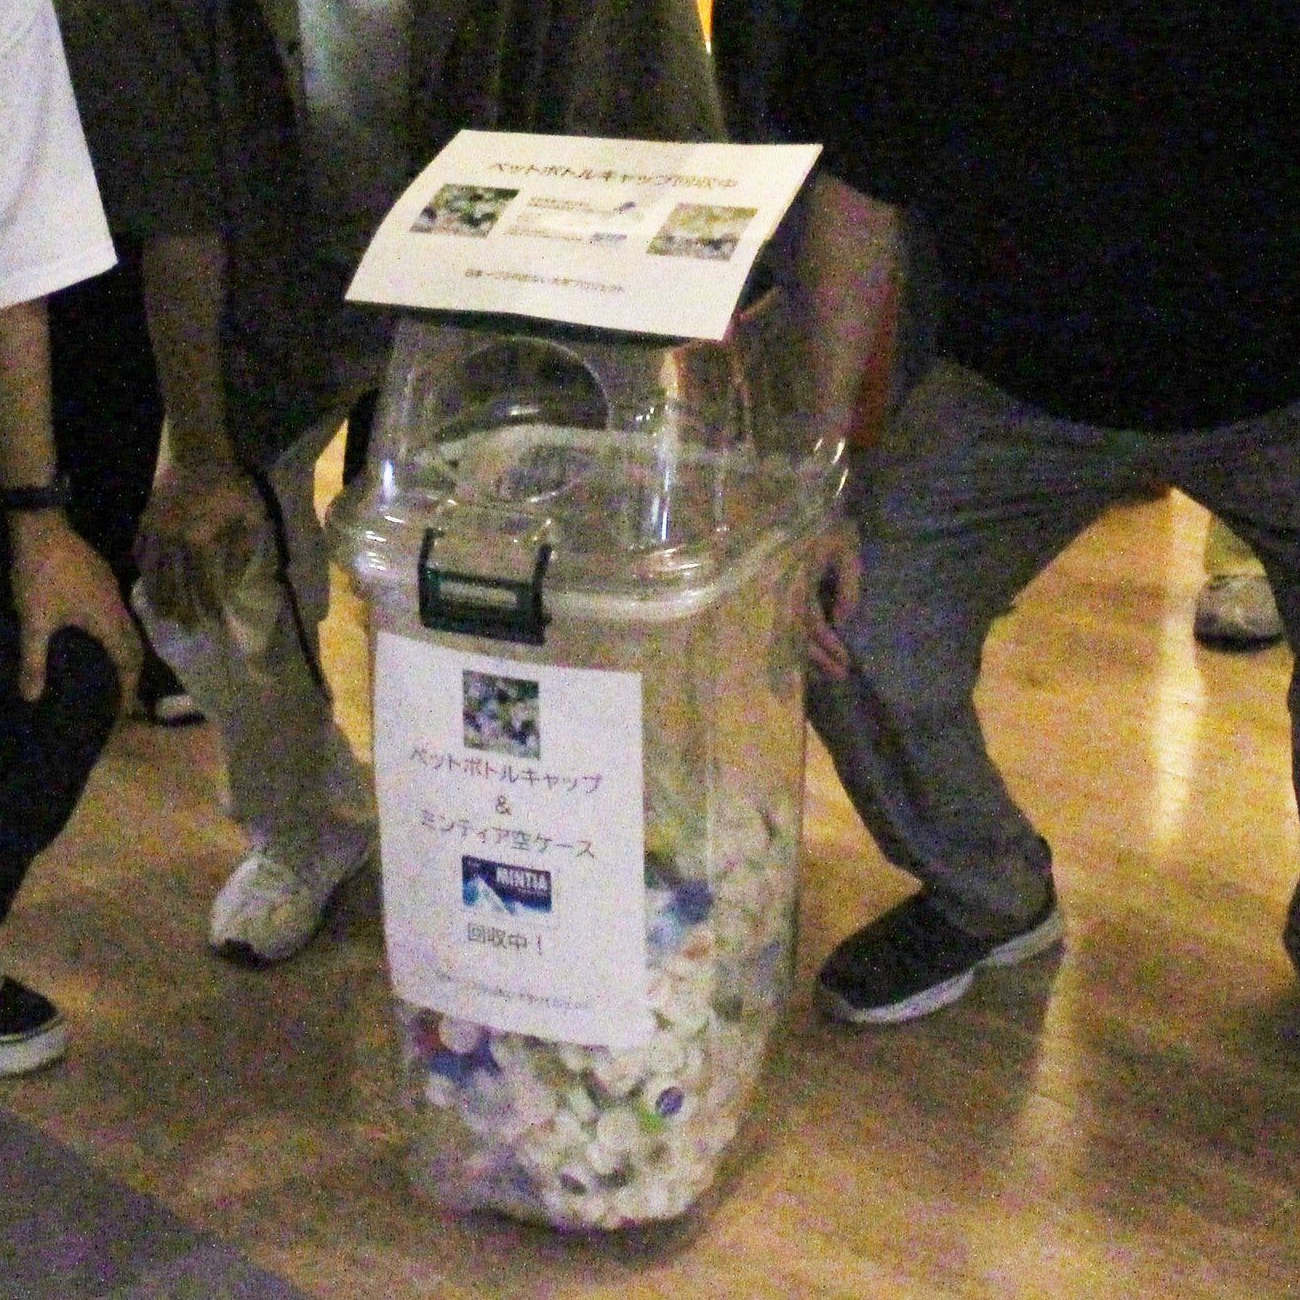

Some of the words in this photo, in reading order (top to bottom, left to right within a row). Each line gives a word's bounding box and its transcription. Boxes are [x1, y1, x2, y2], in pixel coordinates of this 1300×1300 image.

[409, 747, 604, 795] ペットボトルキャップ
[494, 794, 512, 816] &
[421, 809, 595, 859] ミンティア空ケース
